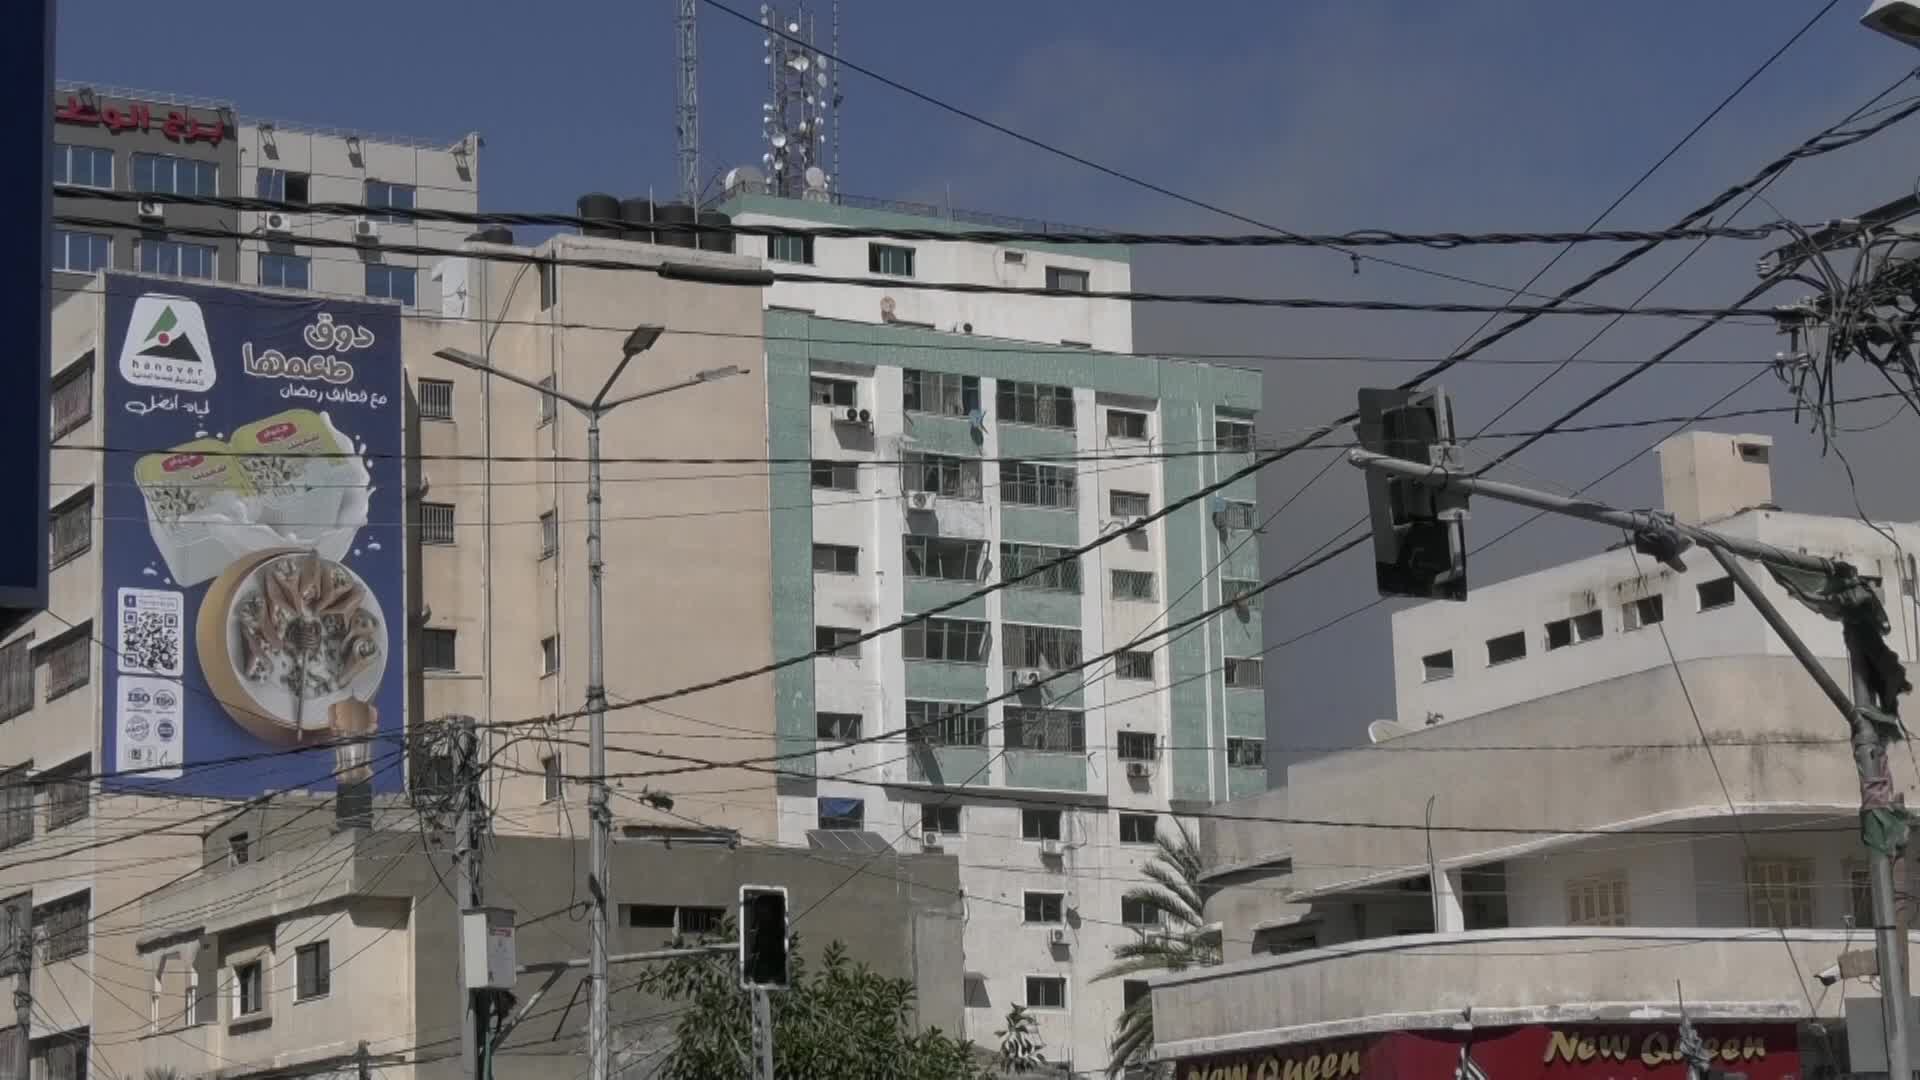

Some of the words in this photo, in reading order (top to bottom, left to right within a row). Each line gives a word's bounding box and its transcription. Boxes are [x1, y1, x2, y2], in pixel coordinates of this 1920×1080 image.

[55, 96, 149, 130] الوط
[162, 111, 224, 143] برج
[131, 359, 203, 376] hanover
[242, 342, 354, 384] طعمها
[280, 384, 323, 403] رمضان
[370, 393, 388, 408] مع
[1543, 1031, 1631, 1063] New
